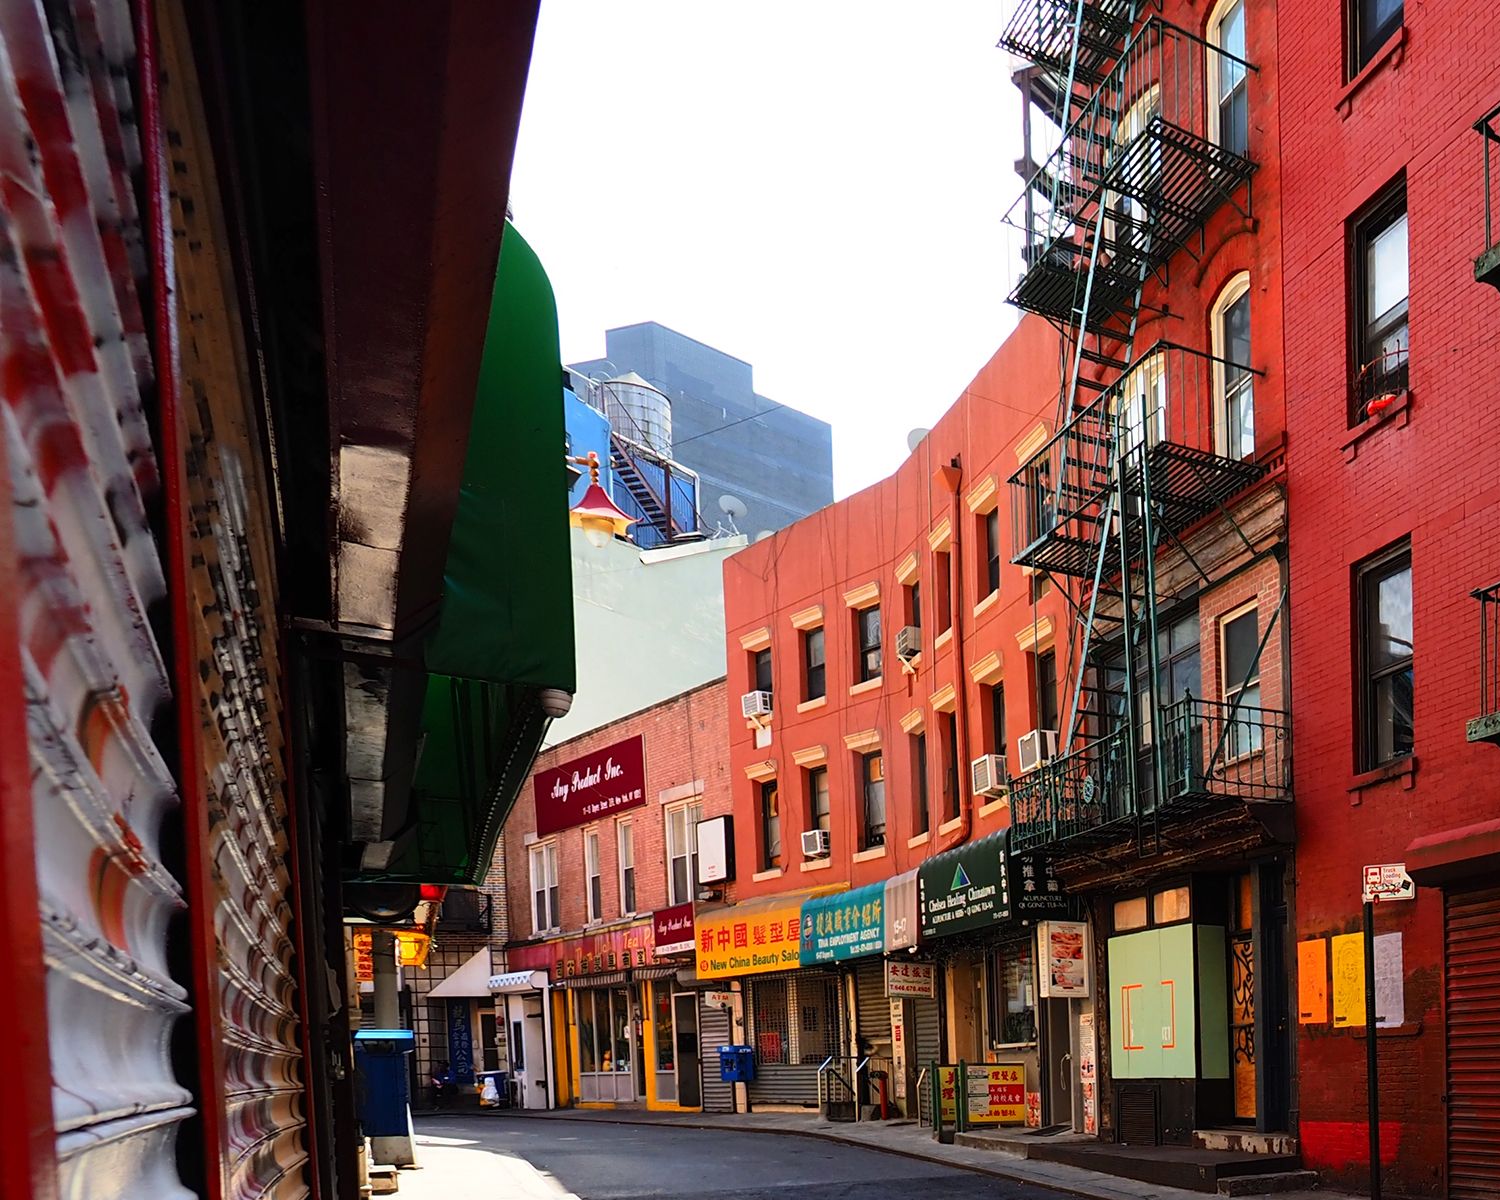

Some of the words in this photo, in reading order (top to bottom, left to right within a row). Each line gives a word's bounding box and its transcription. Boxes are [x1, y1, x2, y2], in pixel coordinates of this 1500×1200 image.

[551, 777, 569, 802] Any
[571, 765, 601, 792] Product
[604, 757, 624, 780] Inc.
[928, 898, 946, 913] Chelsea
[947, 893, 966, 908] Healing
[968, 885, 996, 901] Chinatown
[710, 959, 727, 971] New
[729, 956, 750, 969] China
[752, 952, 779, 966] Beauty
